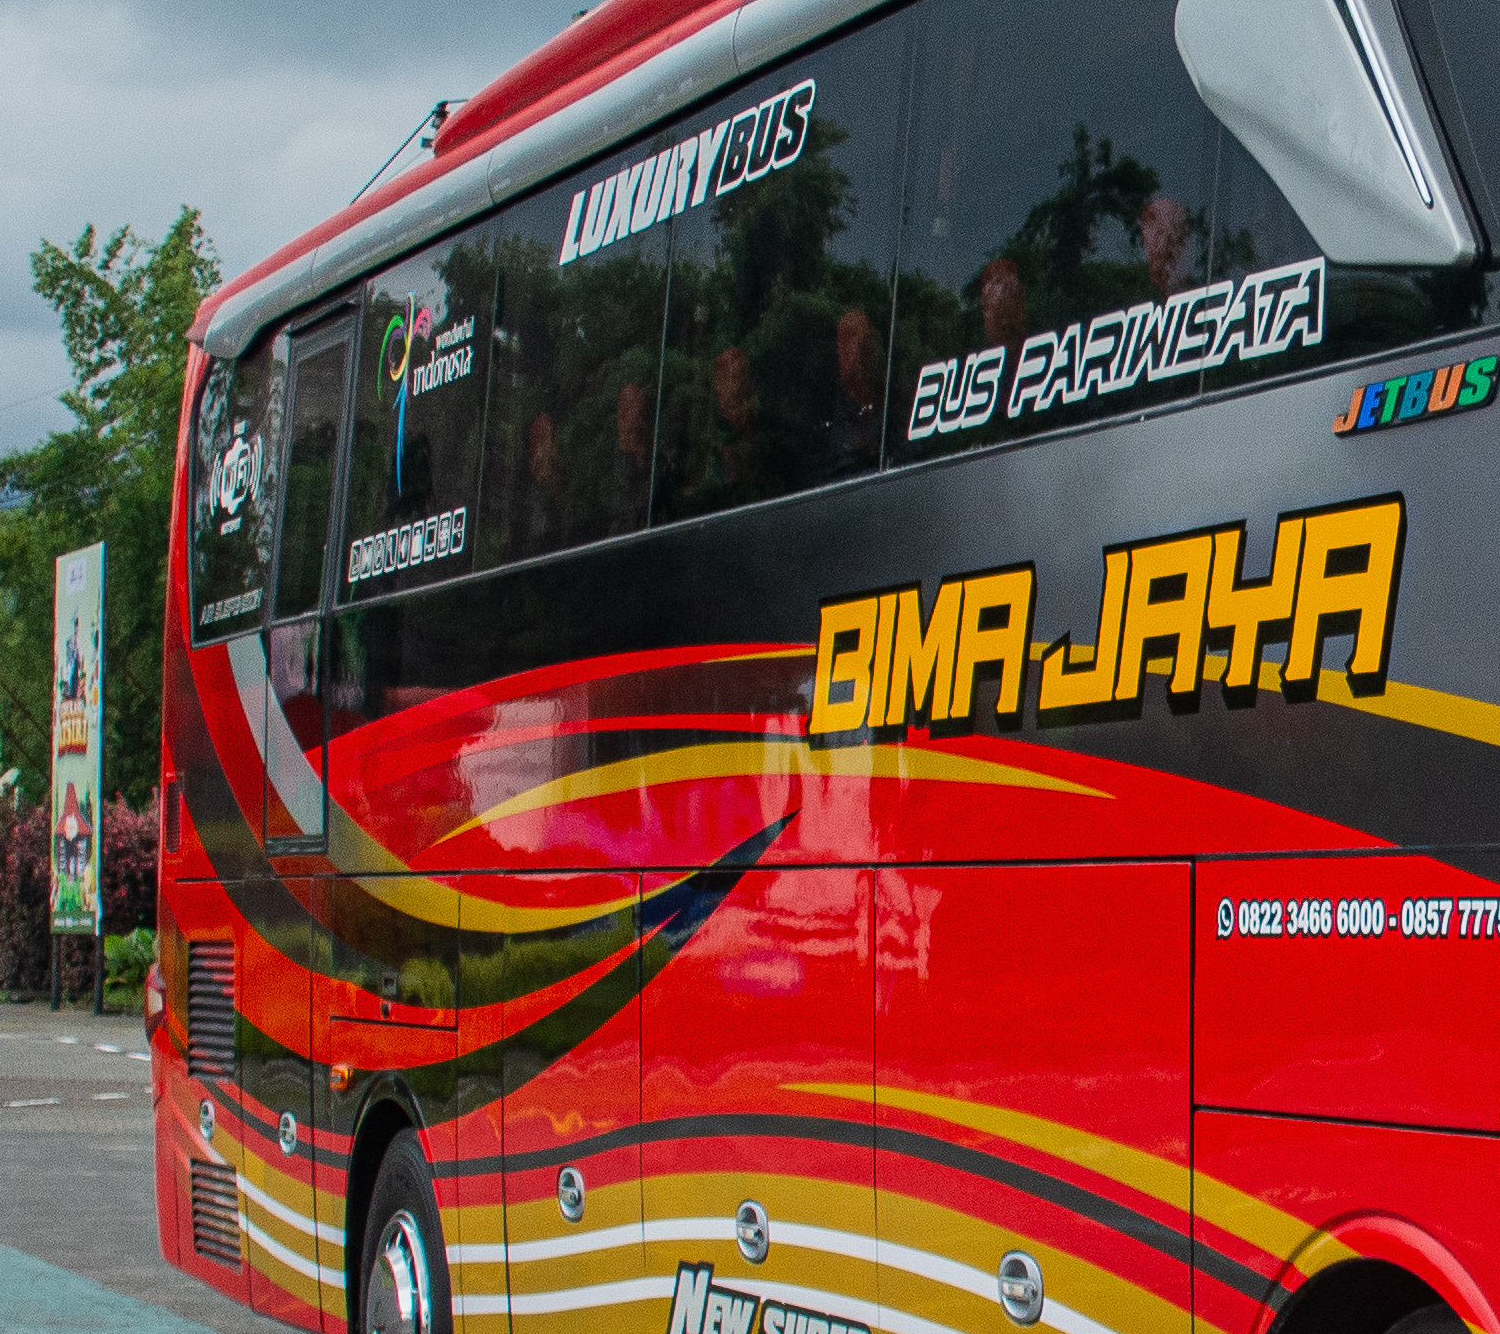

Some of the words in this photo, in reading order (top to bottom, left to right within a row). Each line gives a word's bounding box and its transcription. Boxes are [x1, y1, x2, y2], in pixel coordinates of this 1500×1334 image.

[908, 346, 1005, 441] BUS
[1007, 256, 1325, 418] PARIWISATA
[808, 564, 1035, 745] BIMA
[1038, 495, 1404, 722] JAYA
[1238, 898, 1283, 935] 0822
[1286, 898, 1332, 935] 3466
[1336, 898, 1385, 936] 6000
[1401, 898, 1453, 936] 0857
